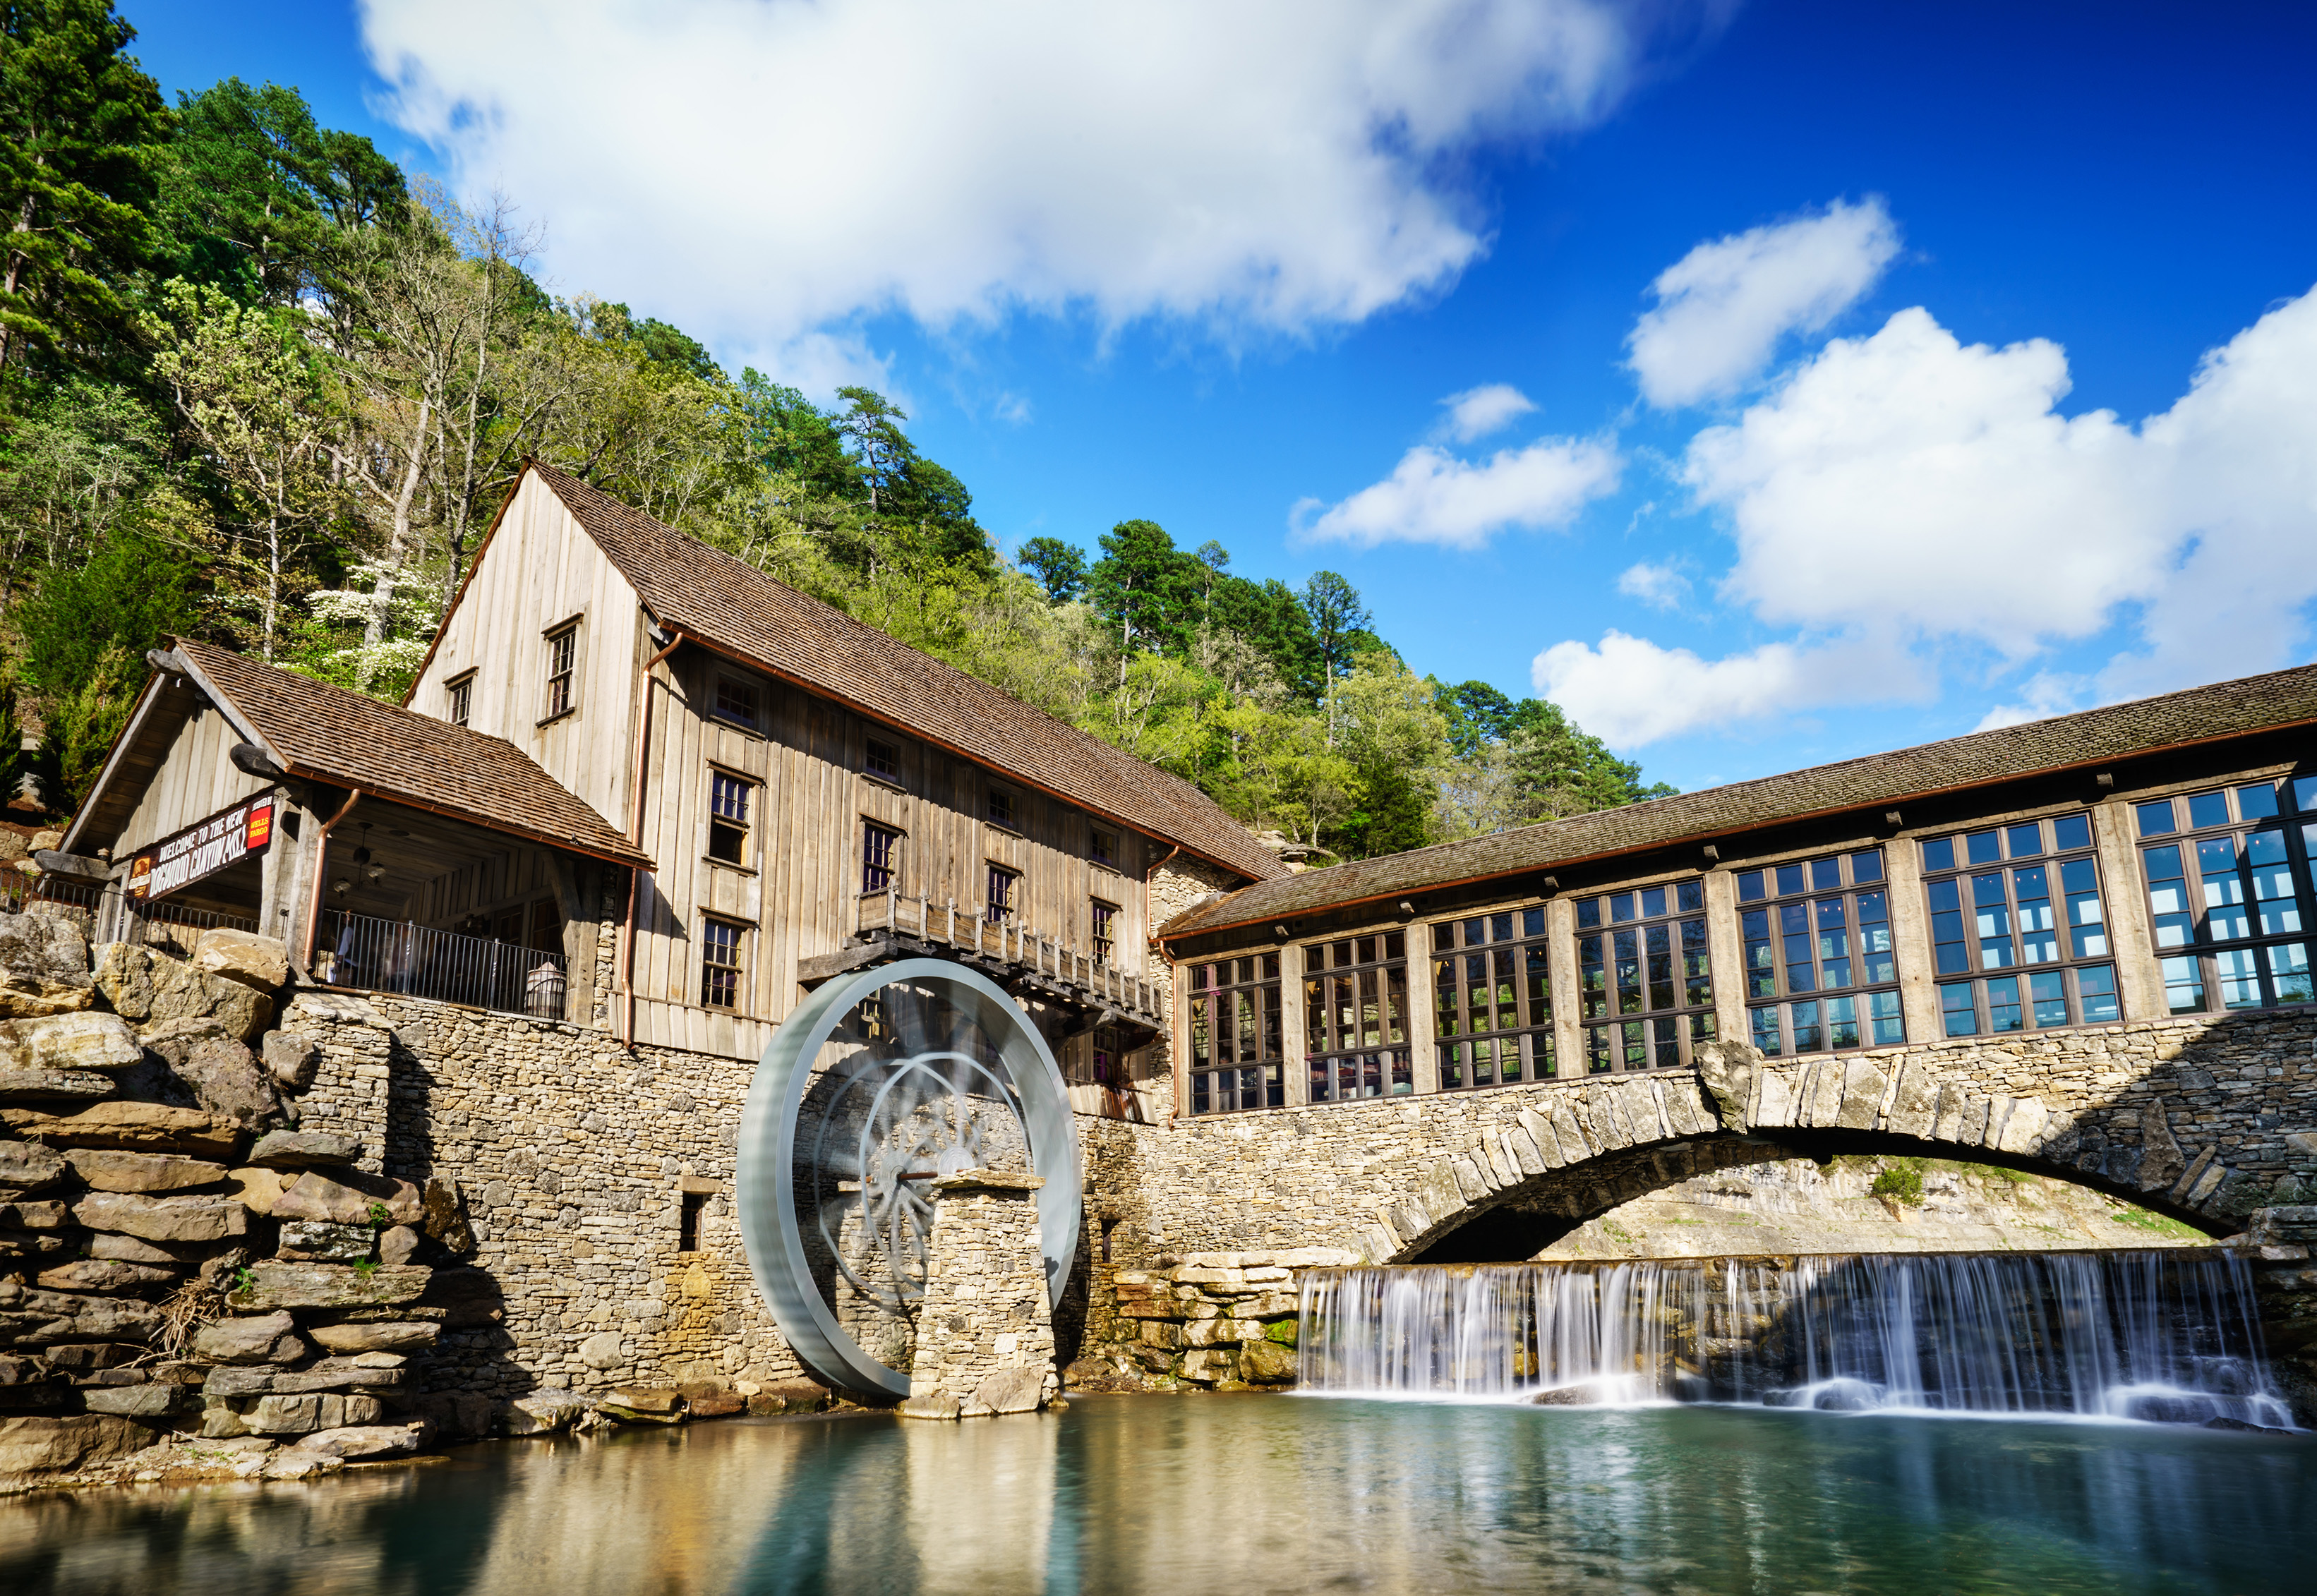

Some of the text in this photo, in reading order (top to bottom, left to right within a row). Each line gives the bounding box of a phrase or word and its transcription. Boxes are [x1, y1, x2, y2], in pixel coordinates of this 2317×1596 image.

[159, 807, 247, 862] WELCOME TO THE NEW
[250, 826, 267, 838] FARGO
[251, 817, 268, 829] WELLS
[149, 824, 246, 897] DOGWOOD CANYON MILL
